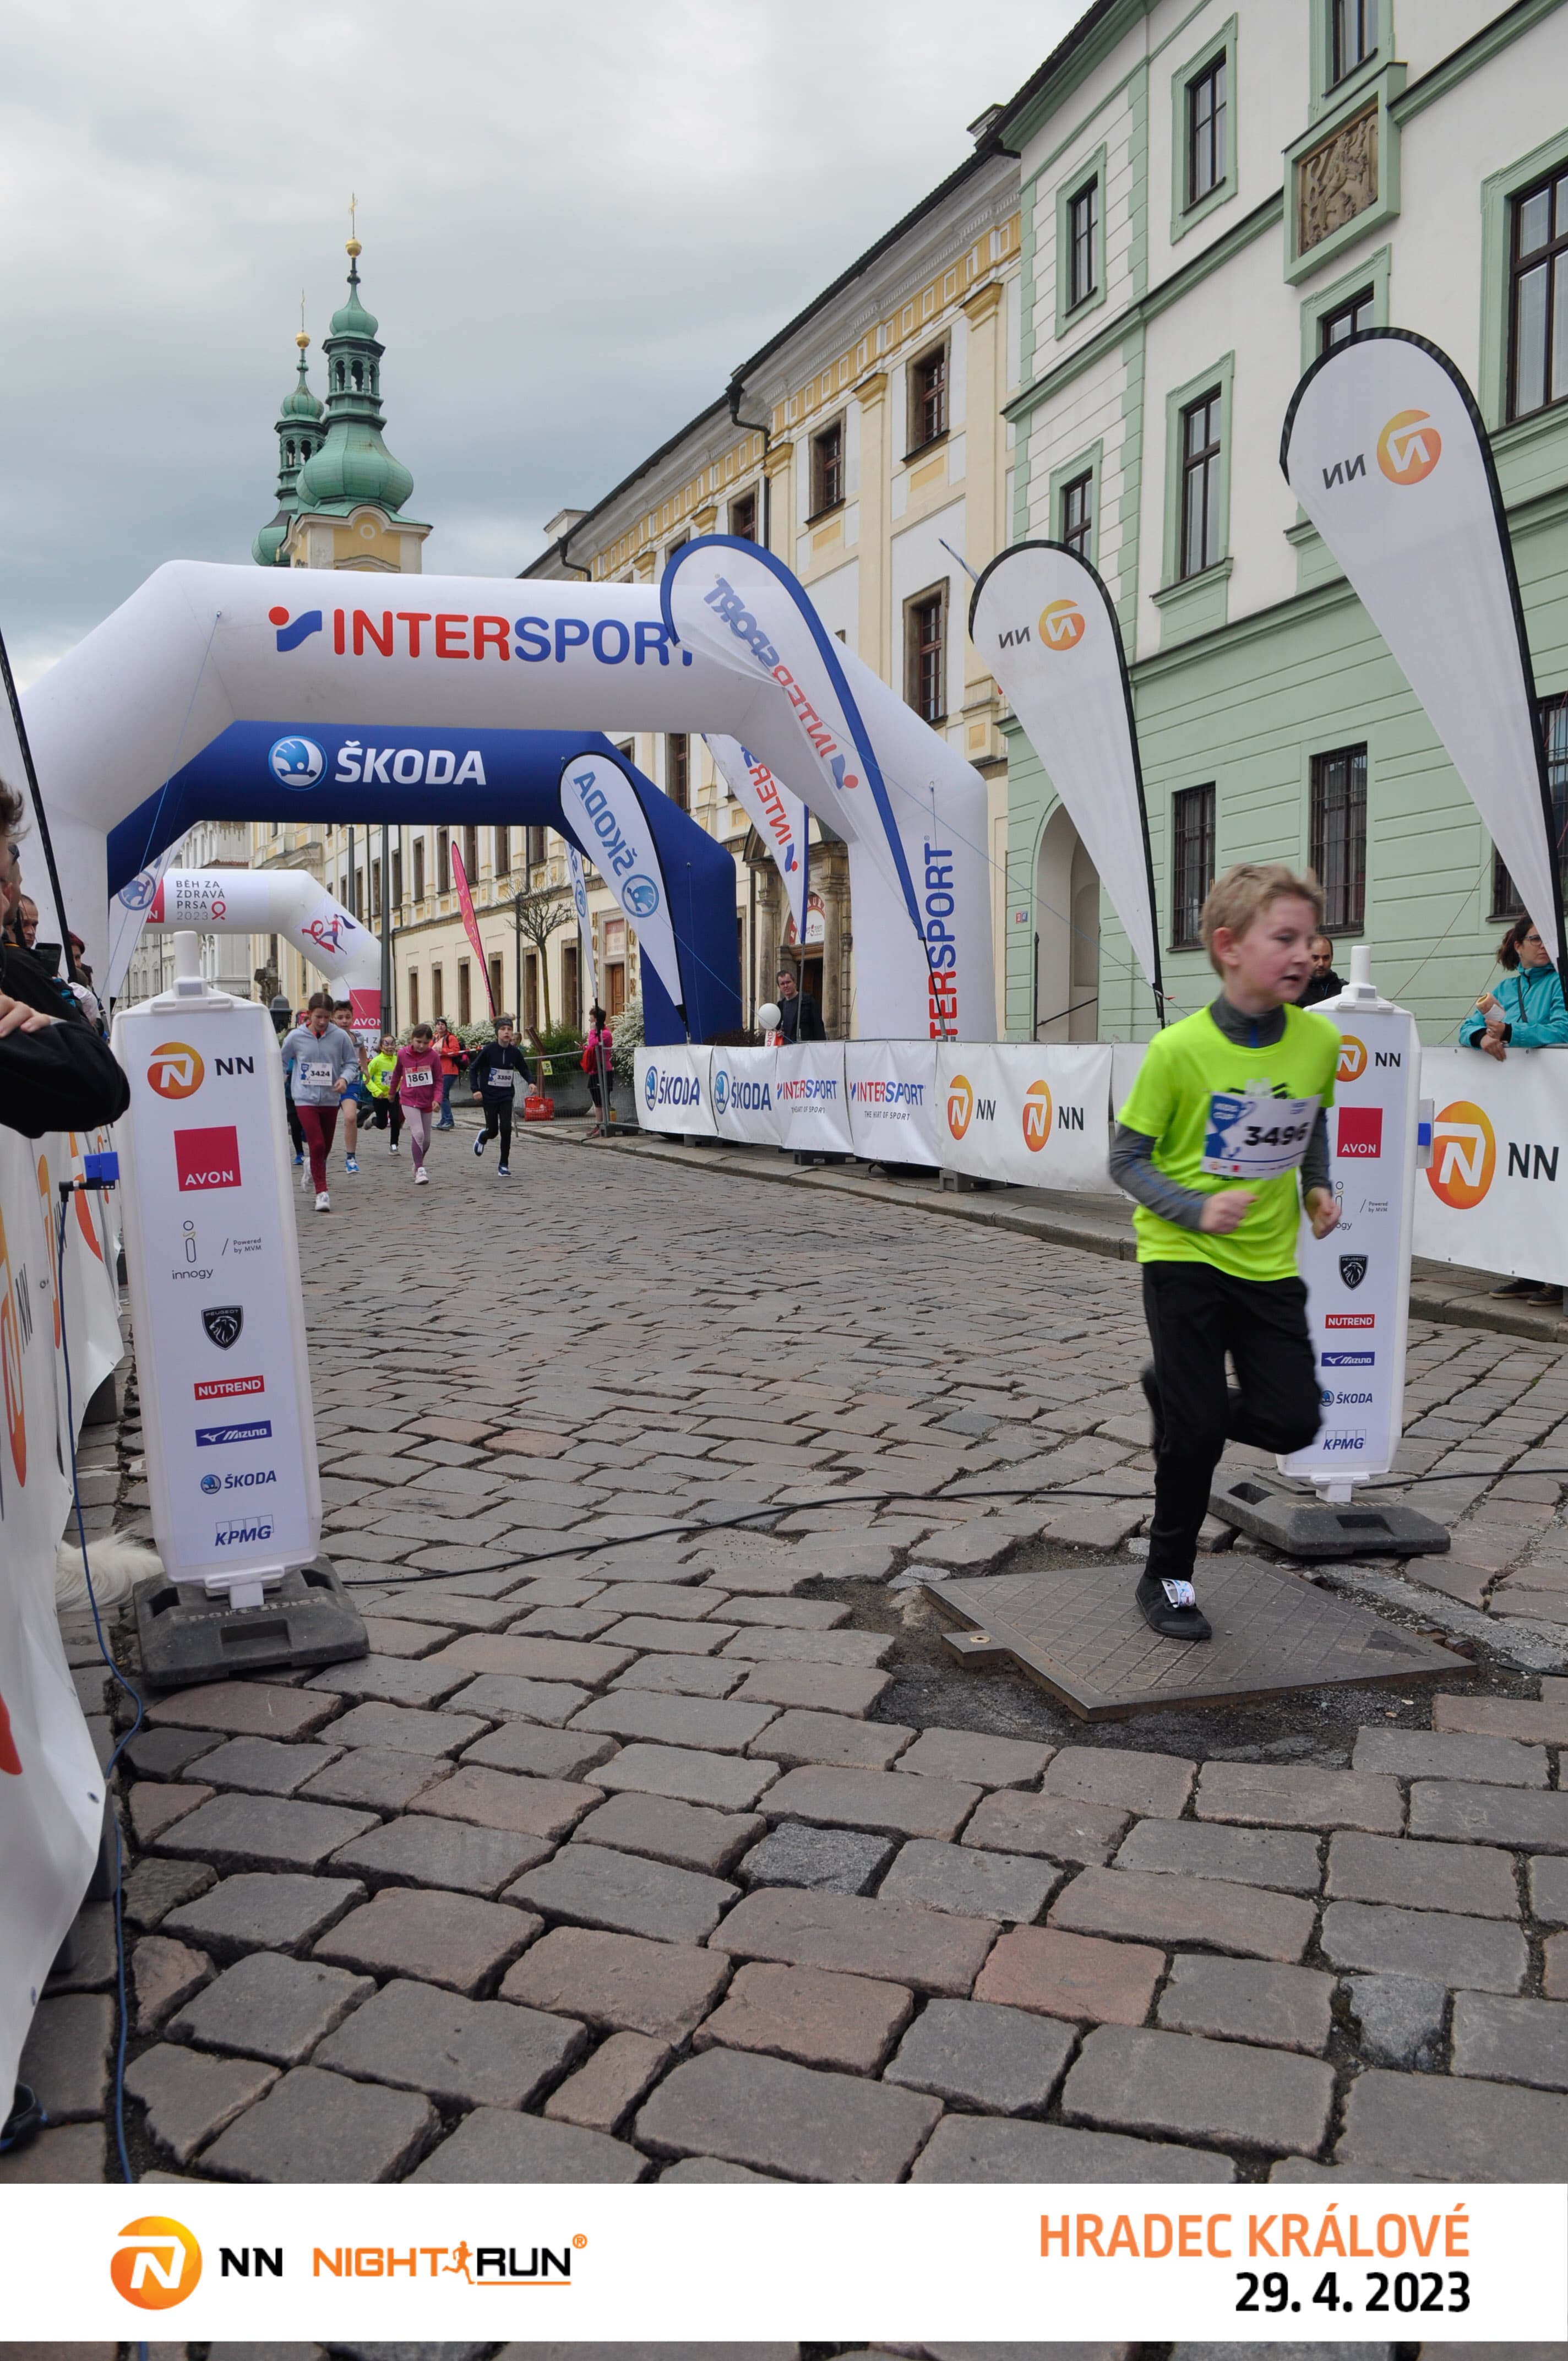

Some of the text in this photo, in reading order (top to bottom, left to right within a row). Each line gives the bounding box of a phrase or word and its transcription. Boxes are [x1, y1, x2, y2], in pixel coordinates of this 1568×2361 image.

[335, 739, 486, 785] ŠKODA
[176, 879, 199, 888] BĚH
[176, 889, 225, 898] ZDRAVÁ
[177, 901, 207, 909] PRSA
[177, 911, 209, 920] 2023
[214, 1056, 254, 1076] NN
[1375, 1052, 1401, 1067] NN
[407, 1072, 428, 1082] 1861
[658, 1070, 700, 1106] ŠKODA
[731, 1076, 772, 1111] ŠKODA
[783, 1079, 837, 1100] INTERSPORT
[857, 1081, 924, 1106] INTERSPORT
[890, 1112, 910, 1120] SPORT
[976, 1099, 996, 1121] NN
[1058, 1106, 1084, 1130] NN
[1341, 1143, 1376, 1154] AVON
[1508, 1142, 1559, 1182] NN
[185, 1171, 233, 1185] AVON
[1335, 1221, 1353, 1231] ogy
[172, 1269, 214, 1280] innogy
[1328, 1317, 1373, 1326] NUTREND
[198, 1379, 261, 1396] NUTREND
[1336, 1391, 1373, 1404] ŠKODA
[1322, 1437, 1364, 1450] KPMG
[224, 1470, 277, 1489] ŠKODA
[215, 1525, 271, 1547] KPMG
